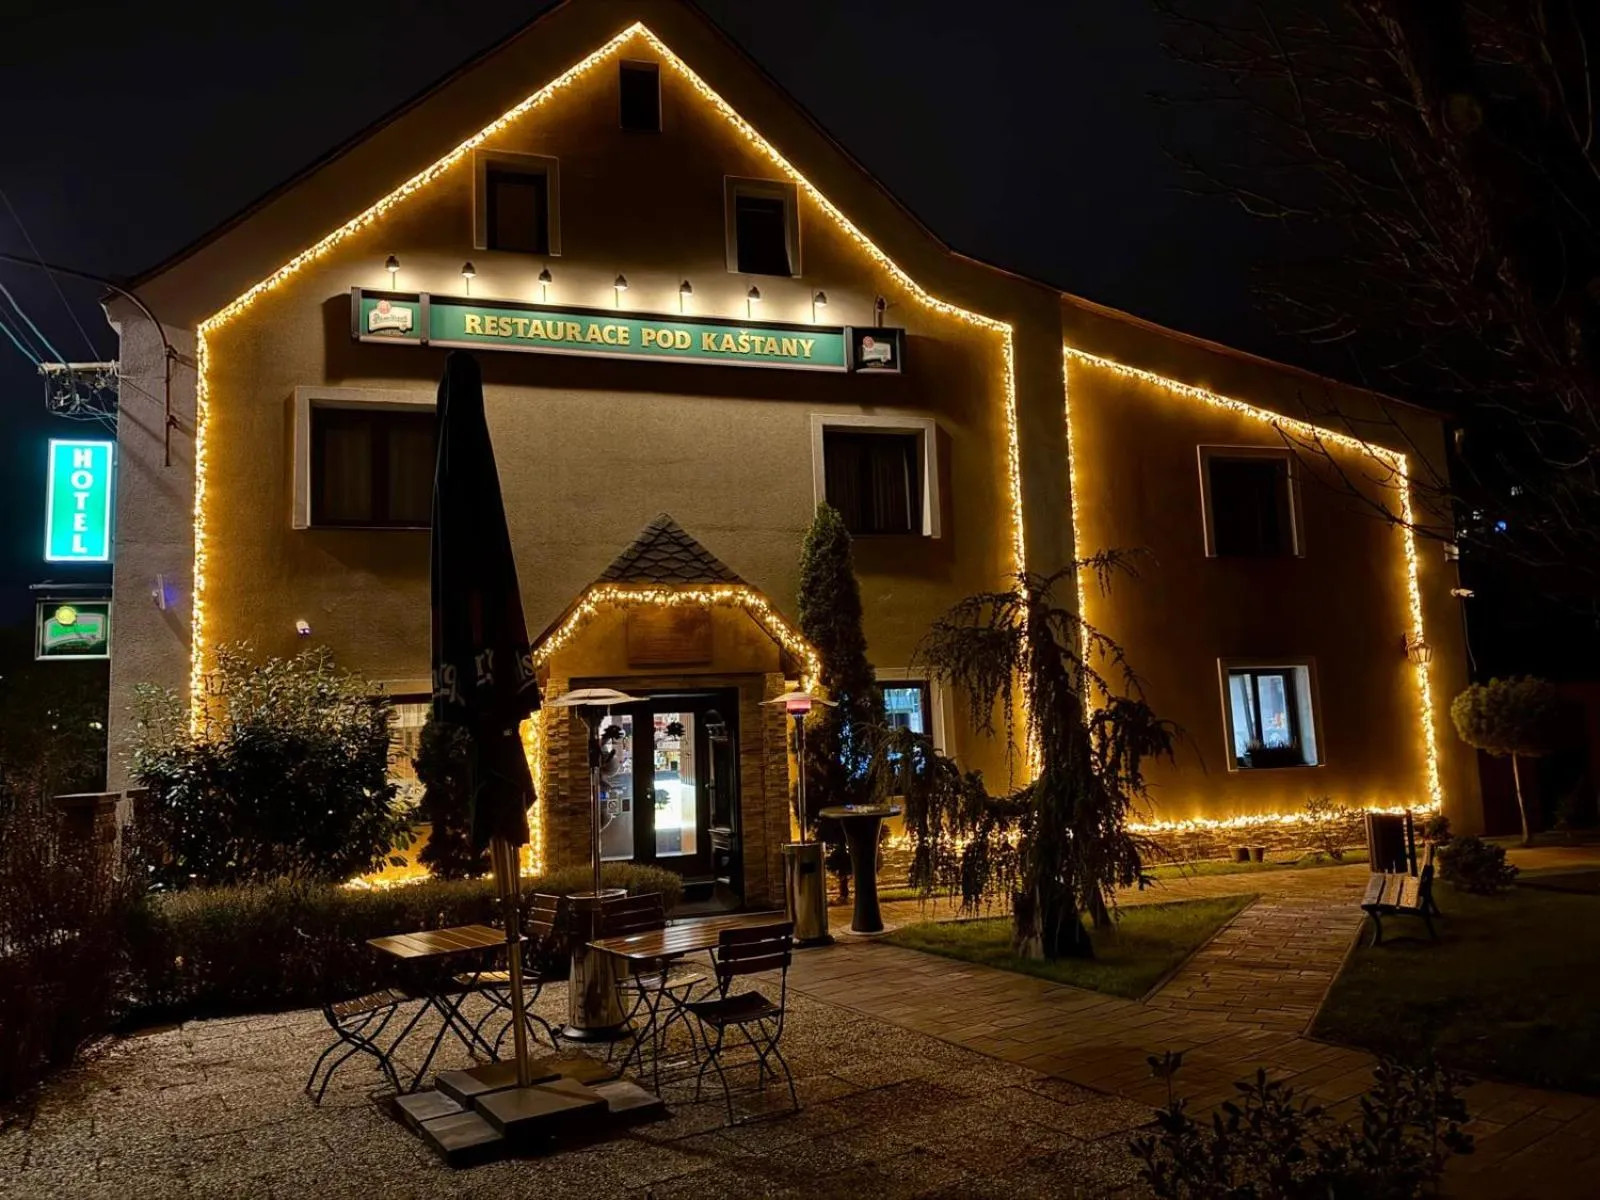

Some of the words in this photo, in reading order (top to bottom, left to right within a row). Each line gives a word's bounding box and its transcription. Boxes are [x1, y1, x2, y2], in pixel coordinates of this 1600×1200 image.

[464, 314, 631, 346] RESTAURACE
[641, 327, 692, 350] POD
[702, 330, 815, 358] KAŠTANY
[70, 447, 94, 554] HOTEL
